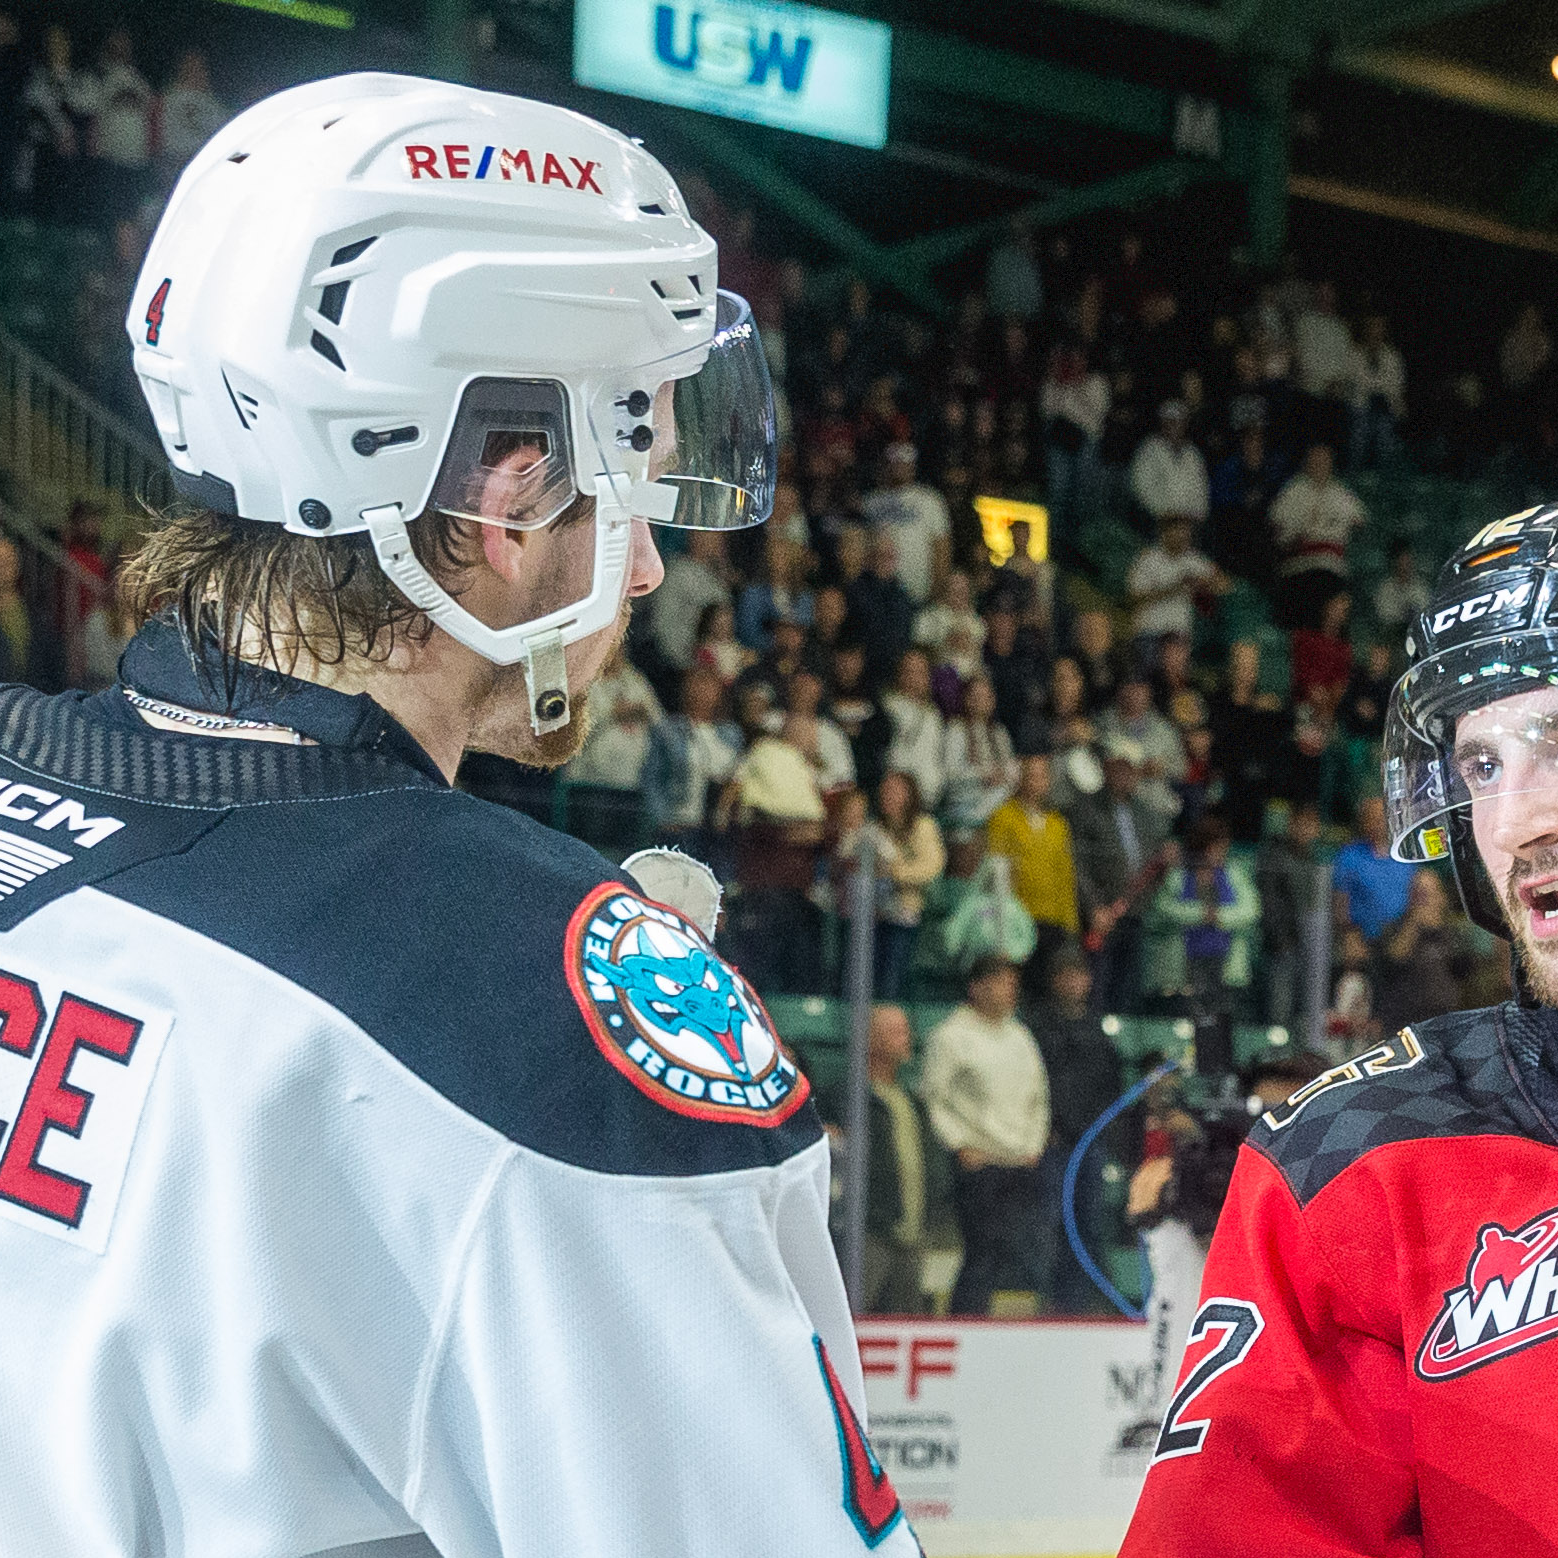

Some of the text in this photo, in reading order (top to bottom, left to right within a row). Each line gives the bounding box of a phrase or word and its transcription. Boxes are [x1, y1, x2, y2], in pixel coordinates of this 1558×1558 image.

[654, 5, 812, 93] USW
[404, 144, 604, 196] RE/MAX
[145, 277, 172, 347] 4
[1432, 582, 1531, 635] CCM
[625, 1036, 798, 1109] ROCKET
[1148, 1296, 1266, 1465] 2
